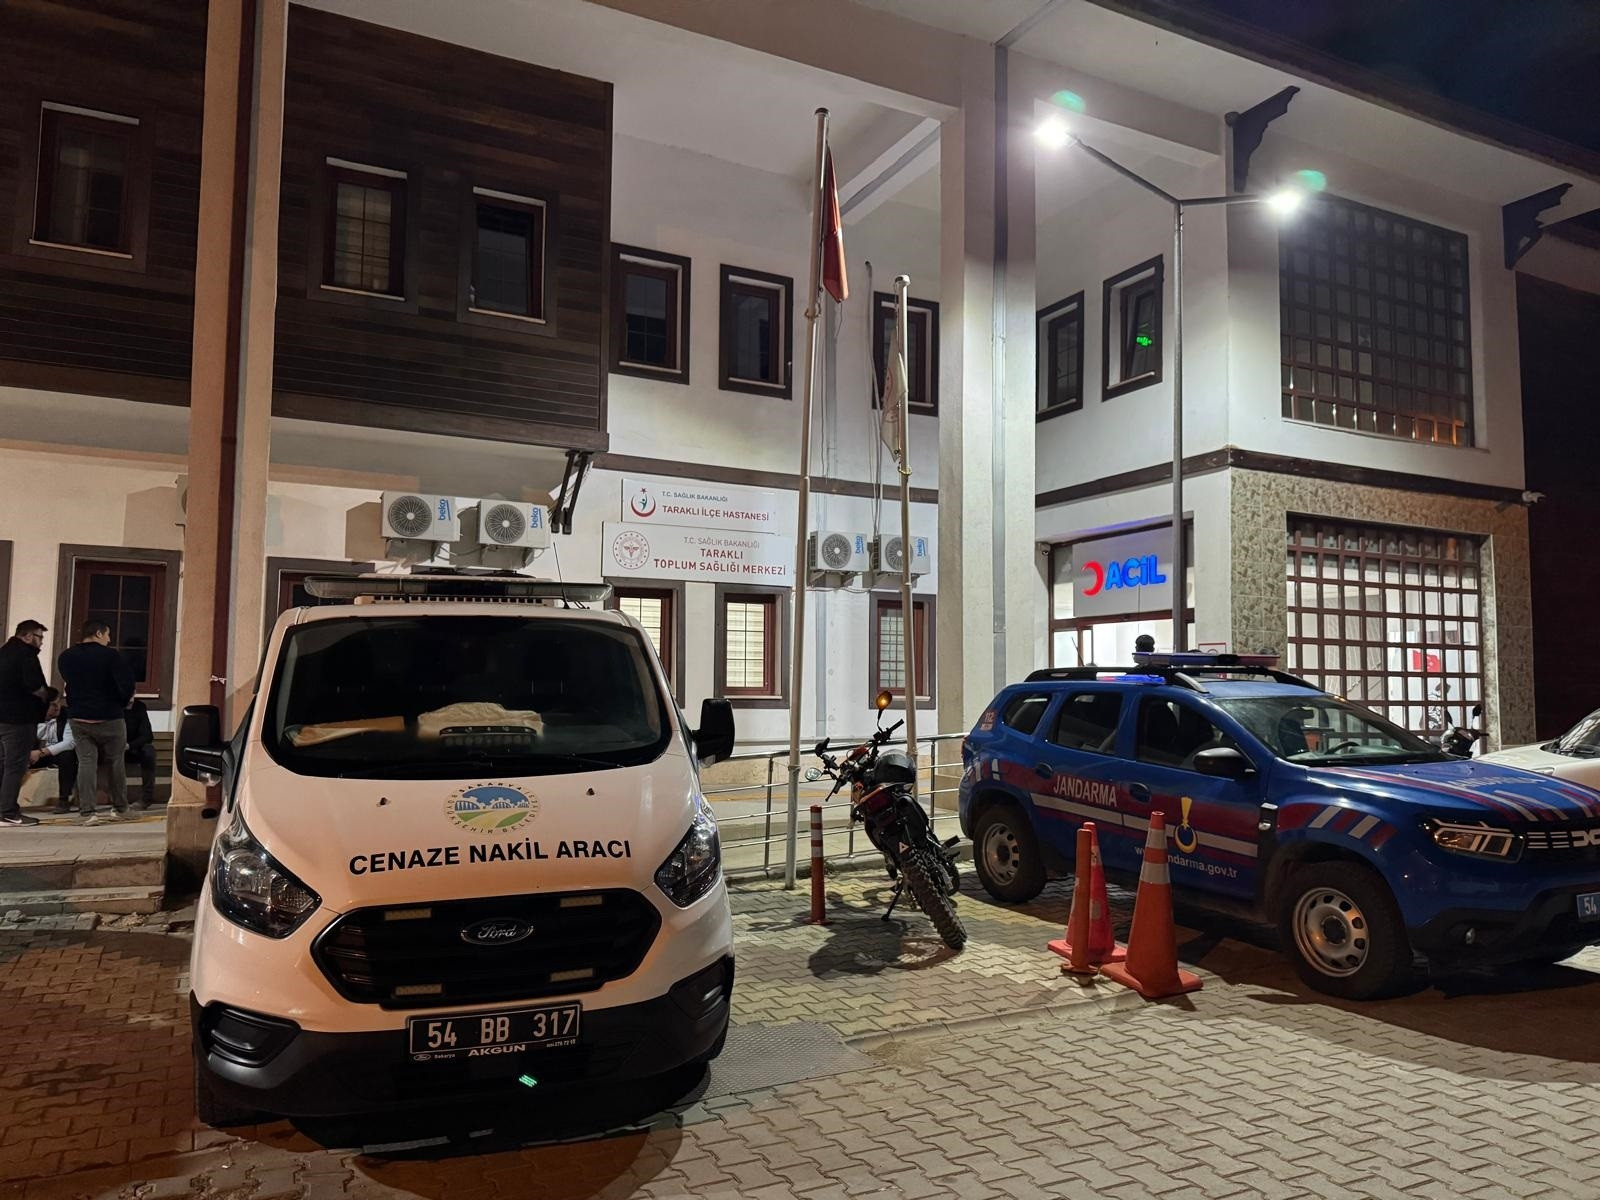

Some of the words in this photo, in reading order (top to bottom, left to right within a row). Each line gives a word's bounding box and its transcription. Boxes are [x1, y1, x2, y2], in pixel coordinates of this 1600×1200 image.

[673, 491, 695, 500] SAĞLIK
[697, 494, 728, 502] BAKANLIĞI
[437, 498, 449, 521] beko
[530, 507, 541, 529] beko
[662, 505, 699, 516] TARAKLI
[701, 508, 720, 518] İLÇE
[722, 510, 769, 521] HASTANESİ
[698, 536, 723, 546] SAĞLIK
[724, 539, 760, 549] BAKANLIĞI
[700, 548, 743, 559] TARAKLI
[654, 559, 697, 571] TOPLUM
[699, 560, 740, 573] SAĞLIĞI
[742, 564, 786, 576] MERKEZİ
[1105, 554, 1166, 590] ACİL
[1053, 774, 1118, 808] JANDARMA
[349, 846, 460, 875] CENAZE
[469, 837, 548, 863] NAKİL
[556, 840, 632, 858] ARACI
[1584, 896, 1597, 914] 54
[478, 924, 517, 939] Ford
[428, 1022, 457, 1048] 54
[481, 1017, 509, 1044] BB
[533, 1010, 576, 1037] 317
